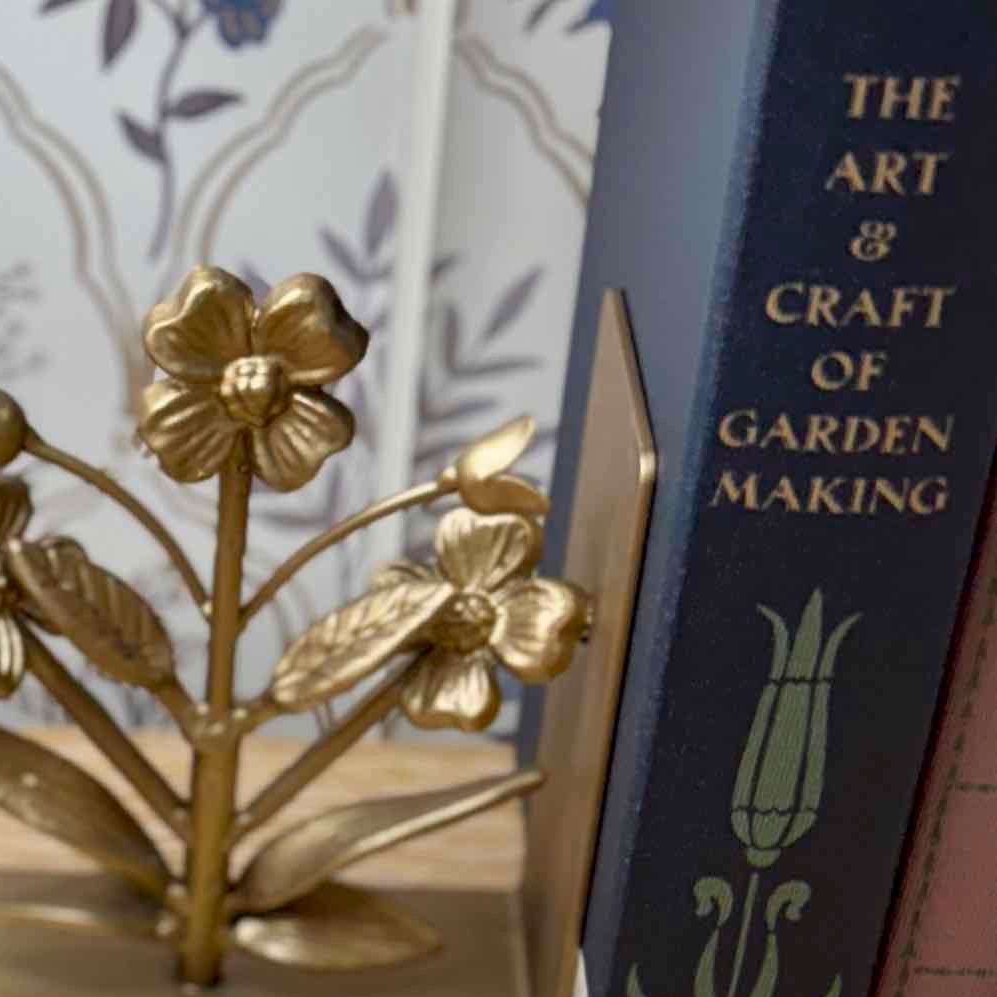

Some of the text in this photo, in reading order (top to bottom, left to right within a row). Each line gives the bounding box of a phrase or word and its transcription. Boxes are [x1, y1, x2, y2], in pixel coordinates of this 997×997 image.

[843, 73, 960, 121] THE
[824, 150, 950, 195] ART
[850, 220, 897, 262] &
[765, 281, 956, 328] CRAFT
[811, 351, 887, 391] OF
[718, 408, 954, 454] GARDEN
[708, 471, 949, 515] MAKING
